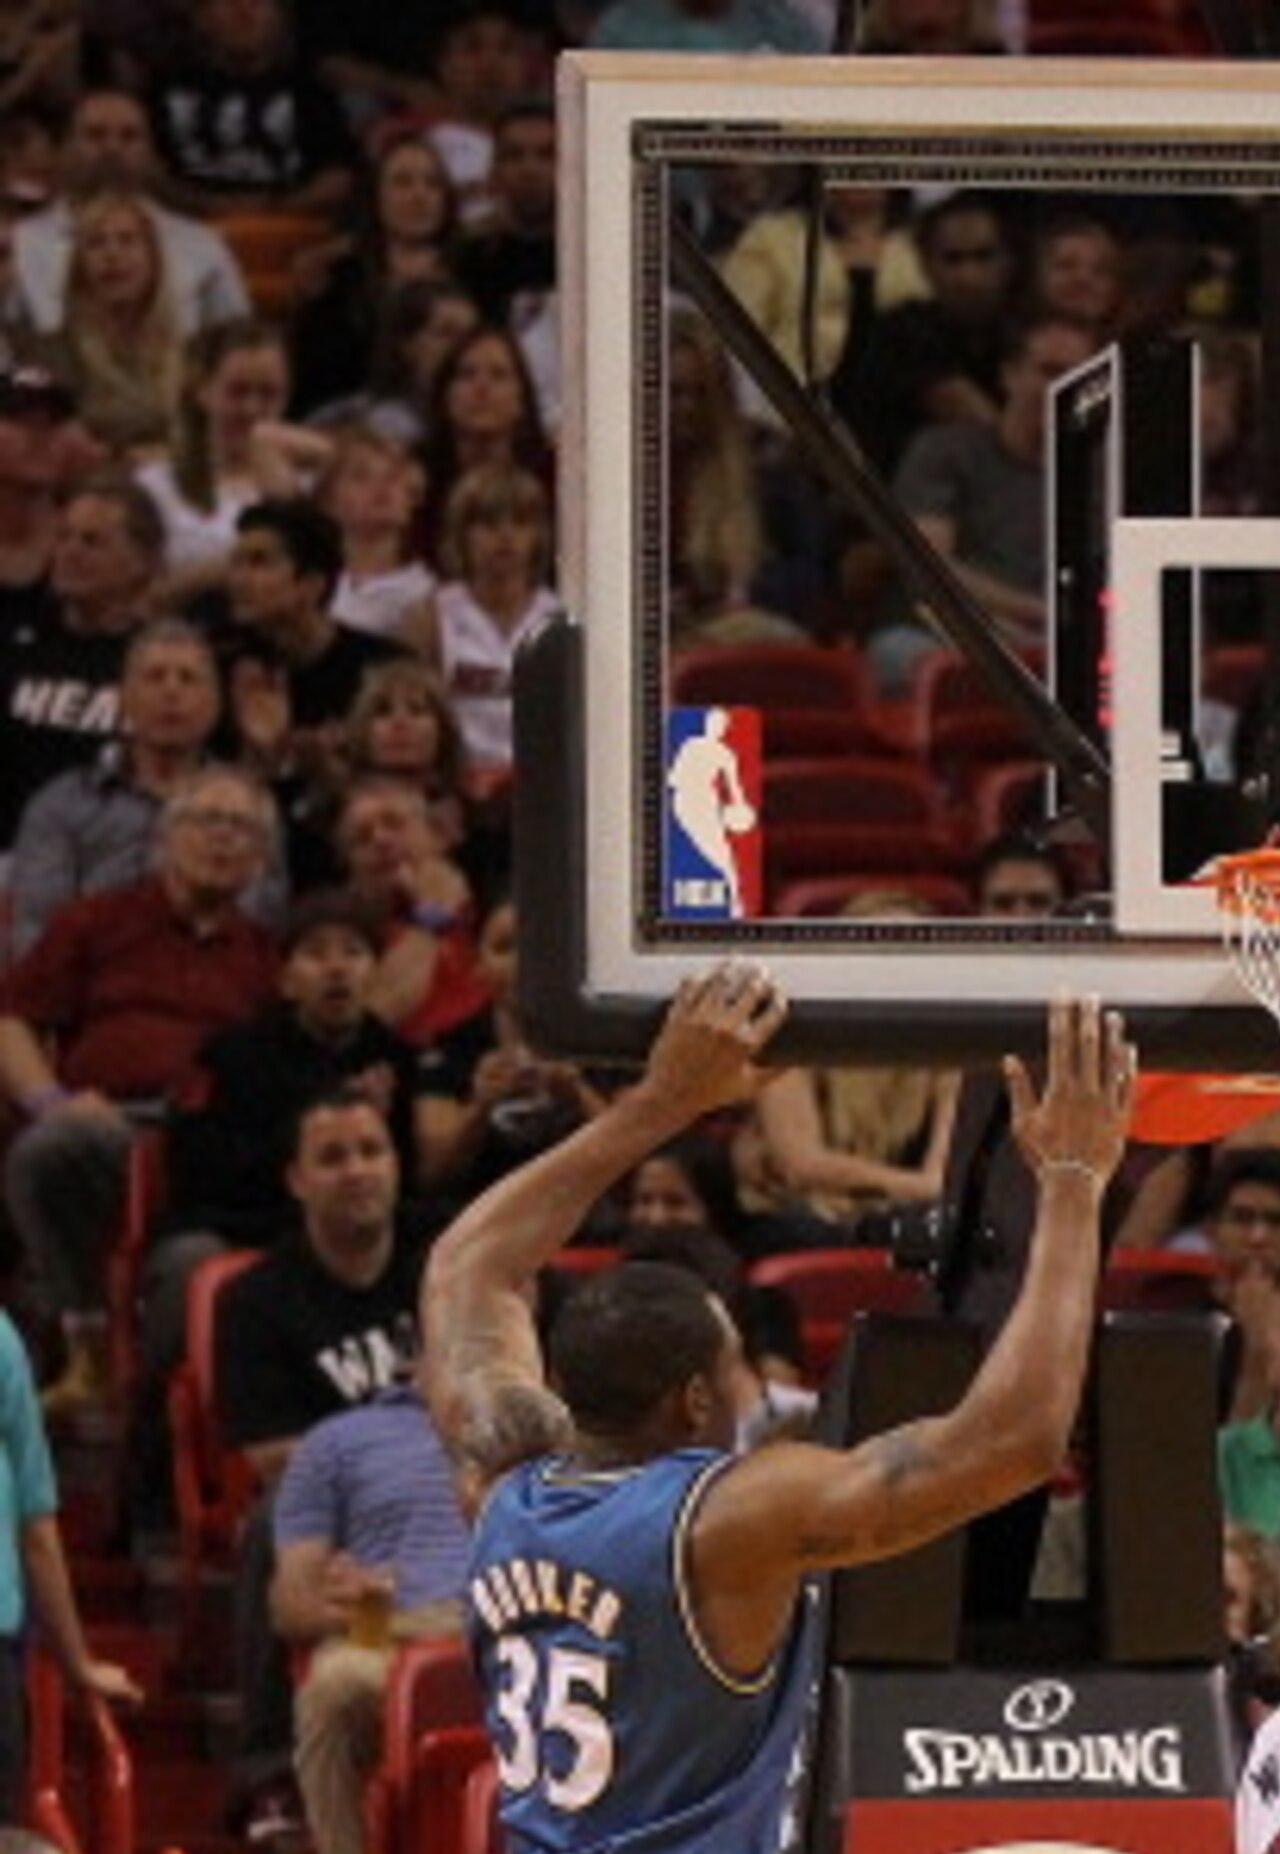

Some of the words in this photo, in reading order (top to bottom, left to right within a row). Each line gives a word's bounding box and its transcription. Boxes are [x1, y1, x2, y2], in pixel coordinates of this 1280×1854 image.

[11, 678, 134, 732] HEA
[494, 1633, 615, 1813] 35
[903, 1726, 1186, 1793] SPALDING
